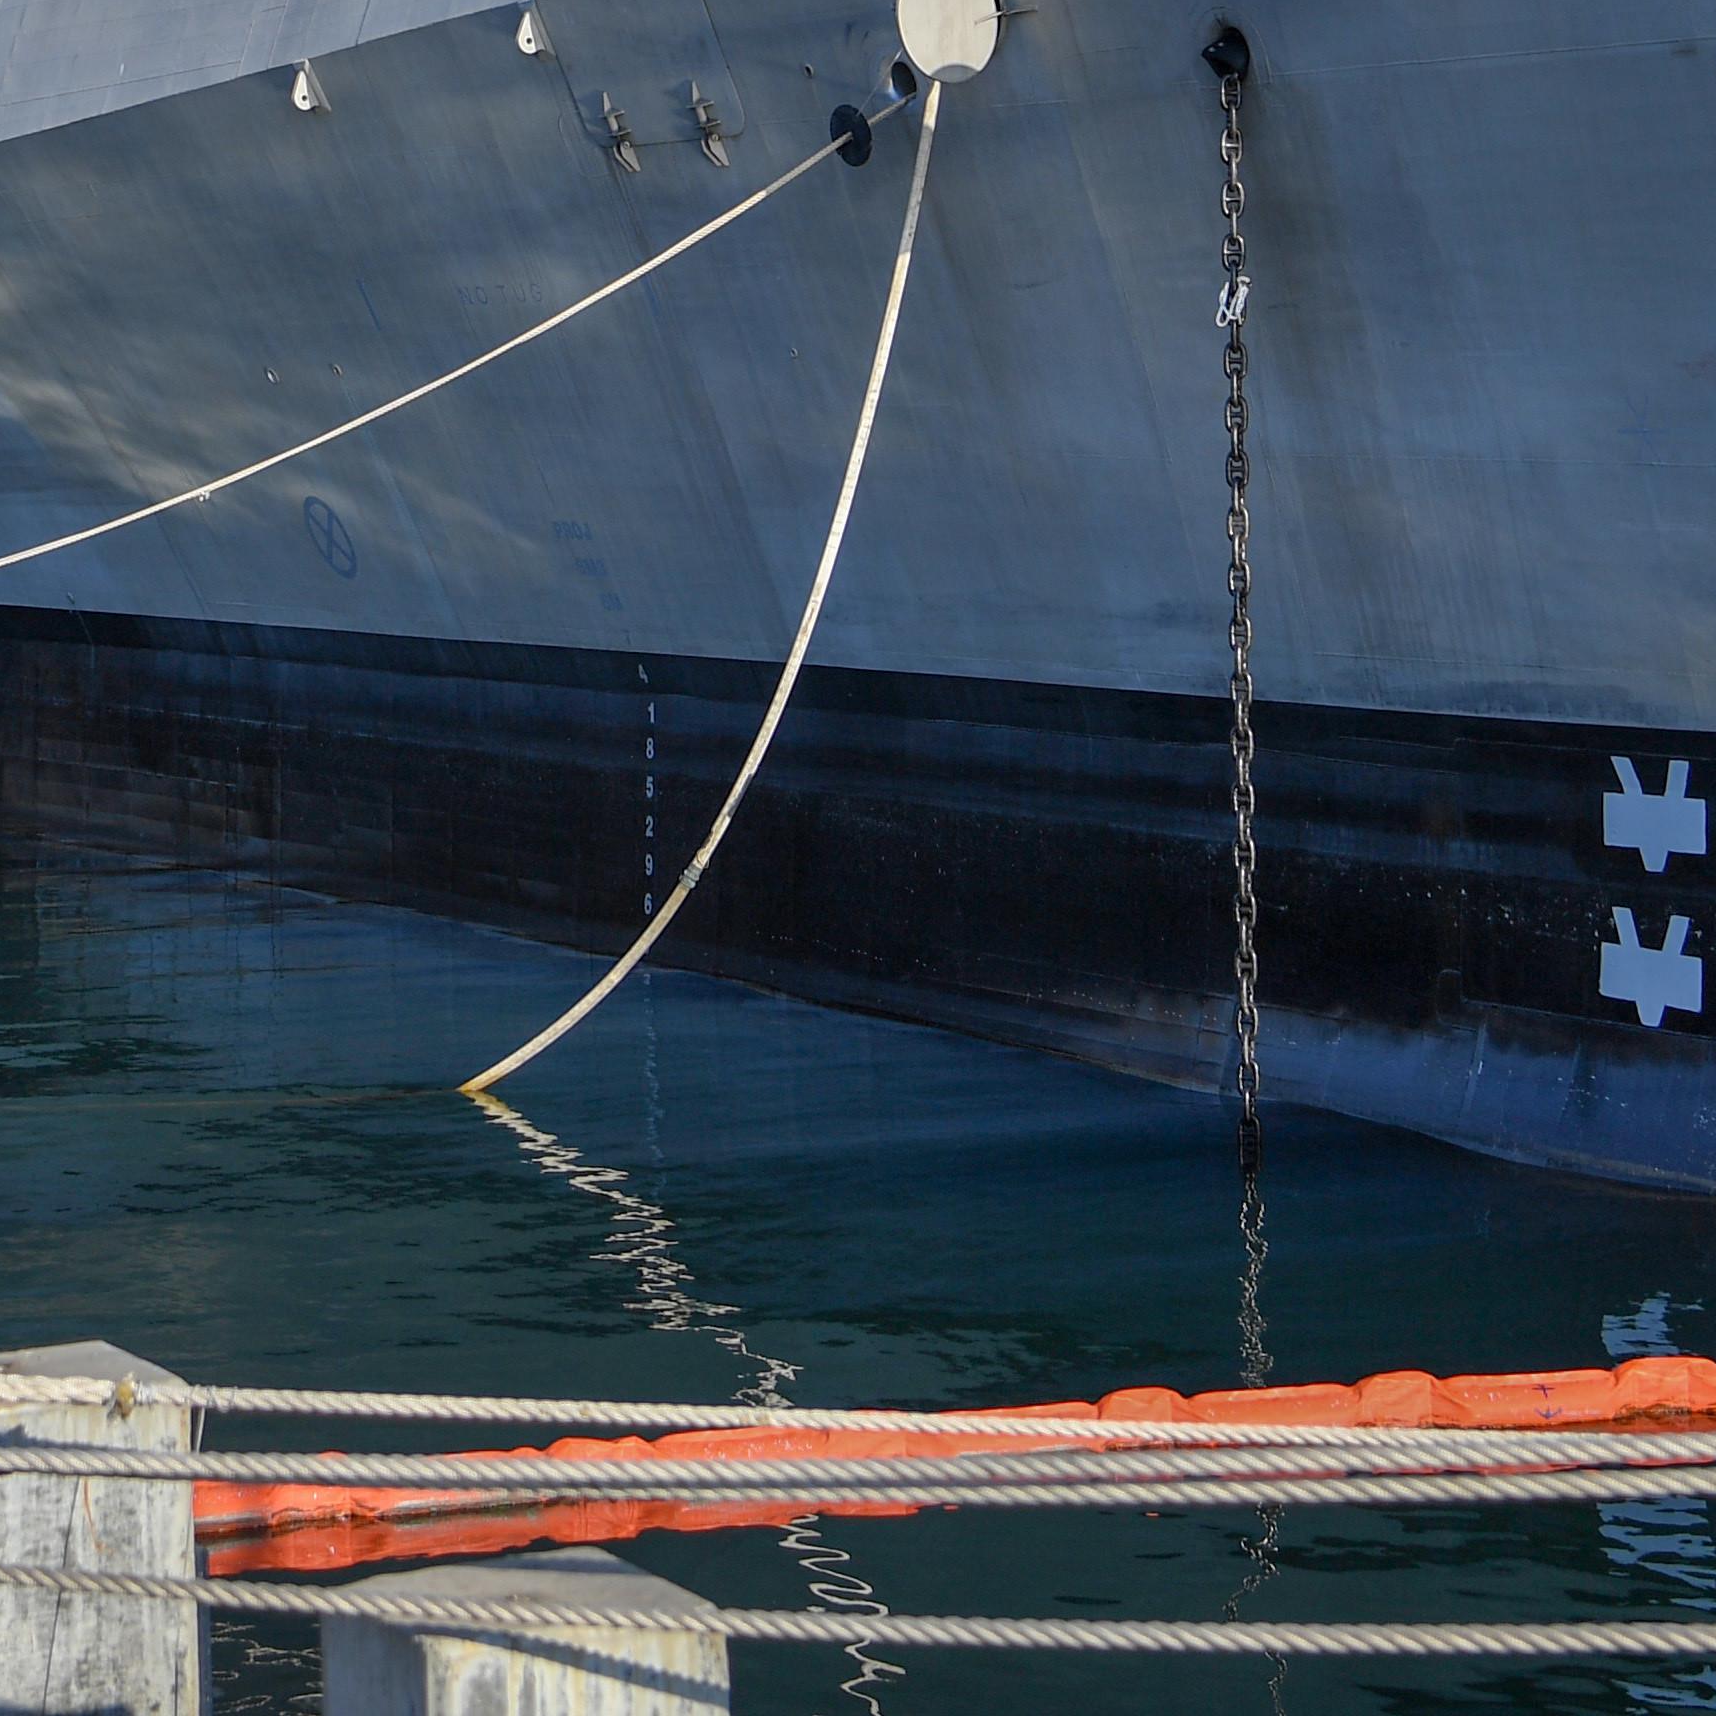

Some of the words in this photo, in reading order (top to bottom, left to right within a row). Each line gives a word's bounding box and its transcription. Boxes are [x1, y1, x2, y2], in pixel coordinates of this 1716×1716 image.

[455, 285, 489, 305] NO
[496, 284, 542, 303] TUG
[647, 702, 656, 724] 1
[645, 738, 655, 759] 8
[644, 777, 655, 798] 5
[644, 816, 654, 837] 2
[644, 854, 654, 876] 9
[644, 893, 654, 916] 6
